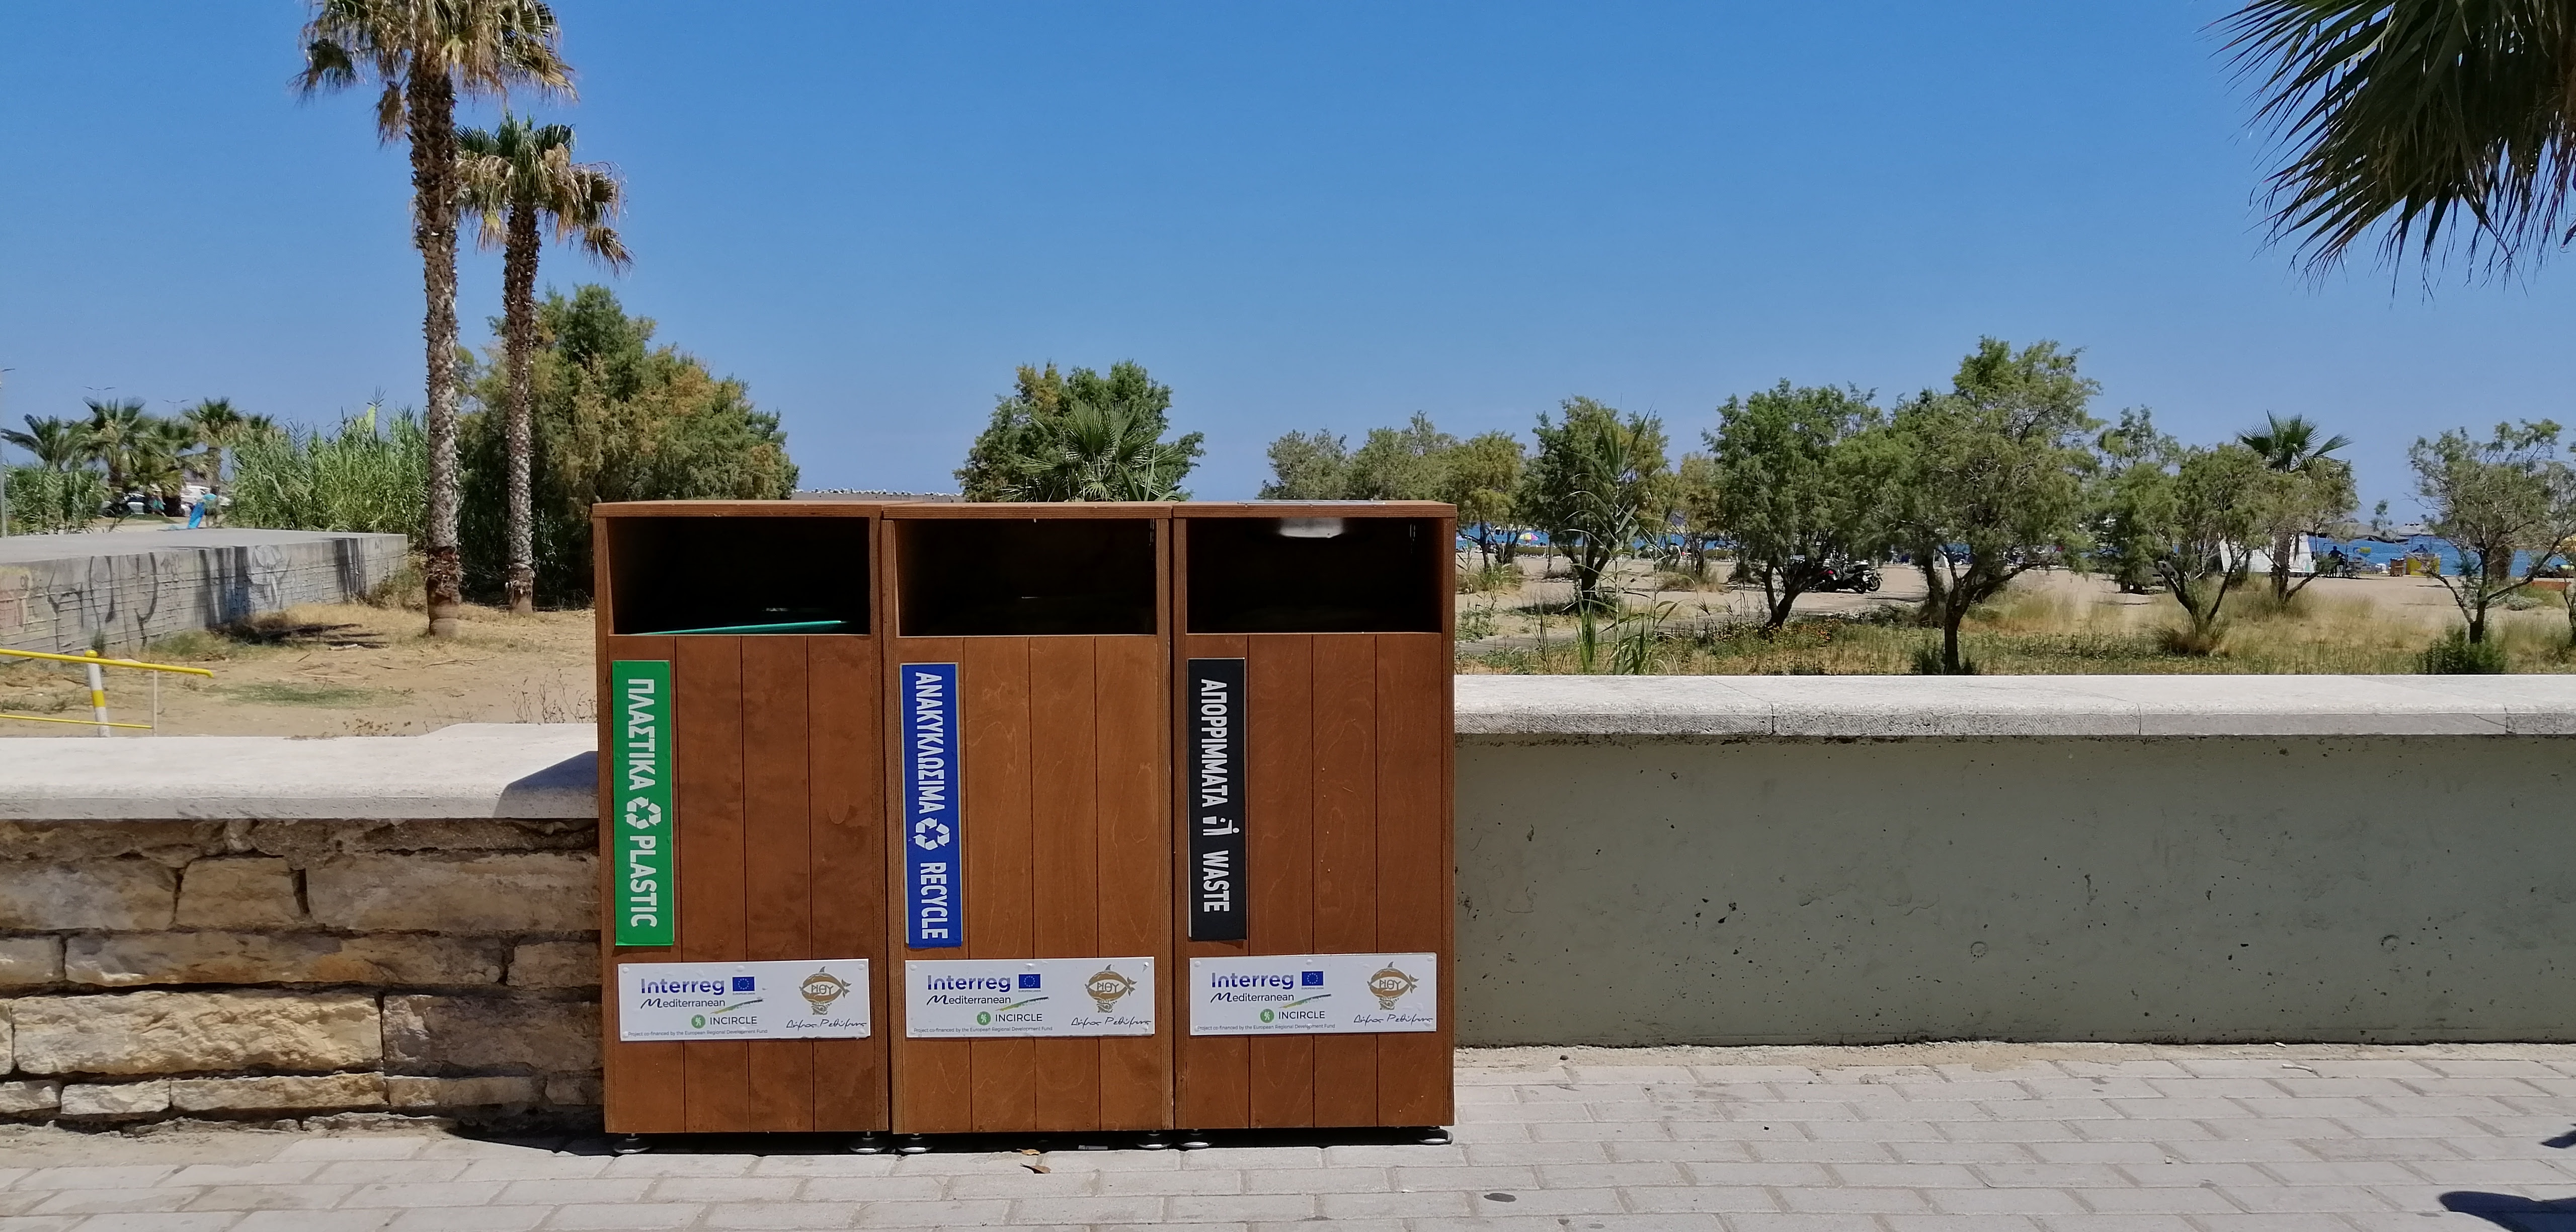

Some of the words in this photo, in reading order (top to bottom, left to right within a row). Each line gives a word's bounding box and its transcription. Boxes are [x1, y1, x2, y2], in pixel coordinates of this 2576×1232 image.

[628, 679, 656, 791] ΠΛΑΣΤΙΚΑ
[915, 672, 945, 814] ΑΝΑΚΥΚΛΩΣΙΜΑ
[1201, 679, 1228, 807] ΑΠΟΡΡΙΜΜΑΤΑ
[629, 835, 658, 927] PLASTIC
[1203, 850, 1230, 912] WASTE
[920, 862, 948, 939] RECYCLE
[641, 978, 725, 995] Interreg
[928, 975, 1010, 992] Interreg
[1212, 972, 1294, 990] Interreg
[640, 998, 726, 1010] Mediterranean
[926, 994, 1011, 1006] Mediterranean
[1211, 992, 1294, 1004] Mediterranean
[710, 1016, 757, 1026] INCIRCLE
[995, 1013, 1042, 1023] INCIRCLE
[1278, 1010, 1325, 1020] INCIRCLE
